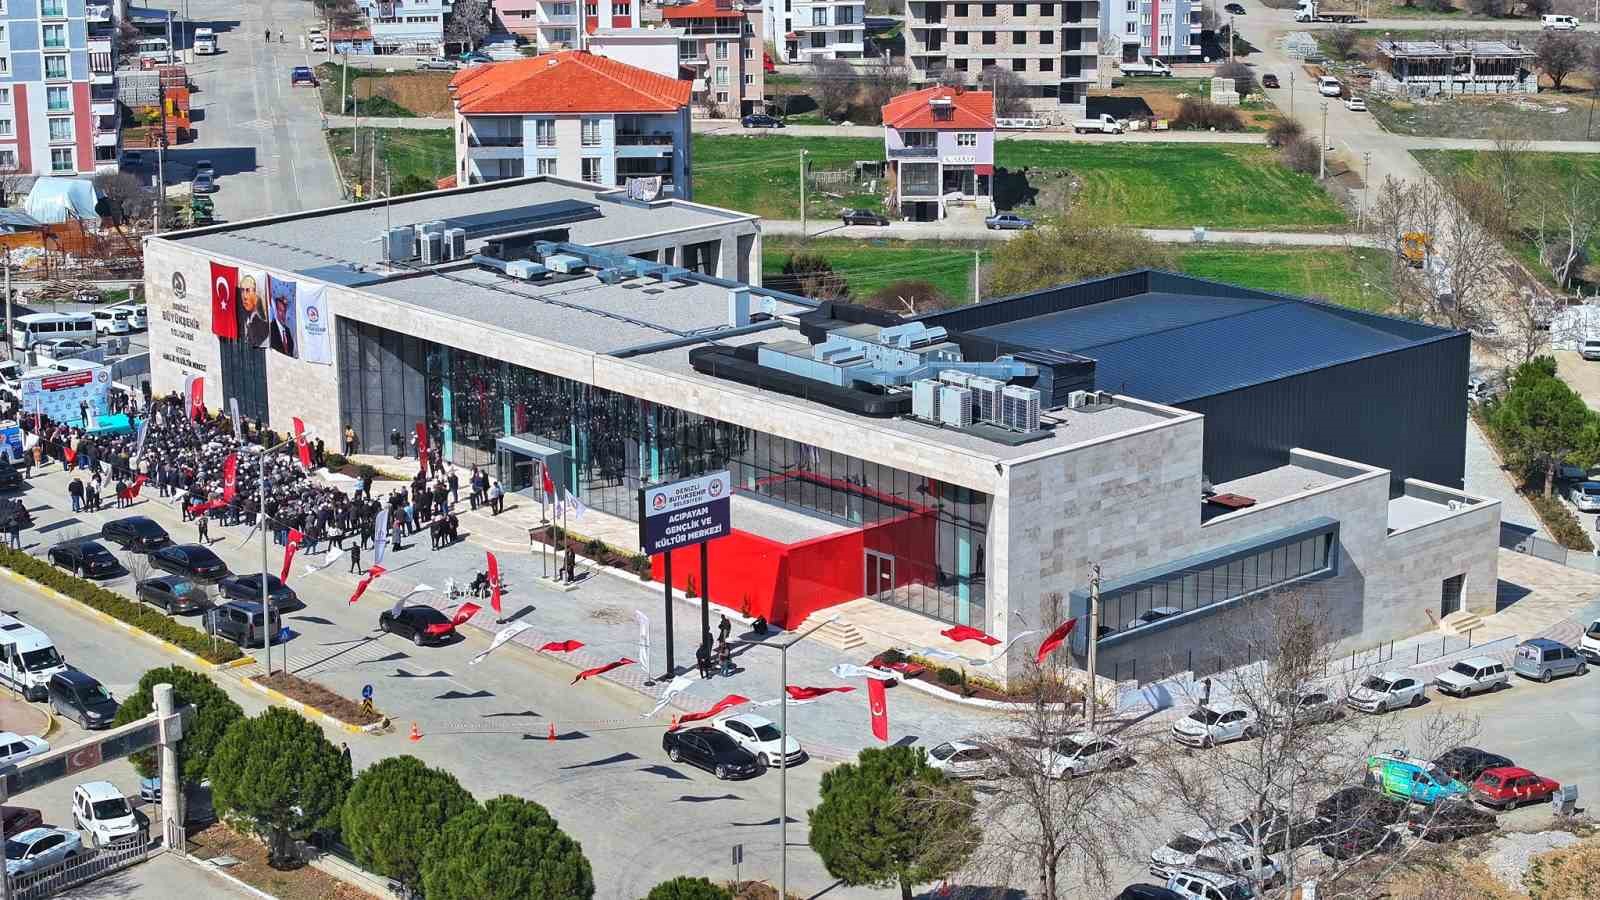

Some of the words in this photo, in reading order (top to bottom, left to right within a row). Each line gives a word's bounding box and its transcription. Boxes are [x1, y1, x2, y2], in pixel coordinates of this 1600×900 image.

[669, 507, 709, 523] ACIPAYAM
[665, 520, 700, 535] GENÇLİK
[701, 516, 712, 526] VE
[656, 534, 686, 549] KÜLTÜR
[688, 523, 722, 539] MERKEZİ
